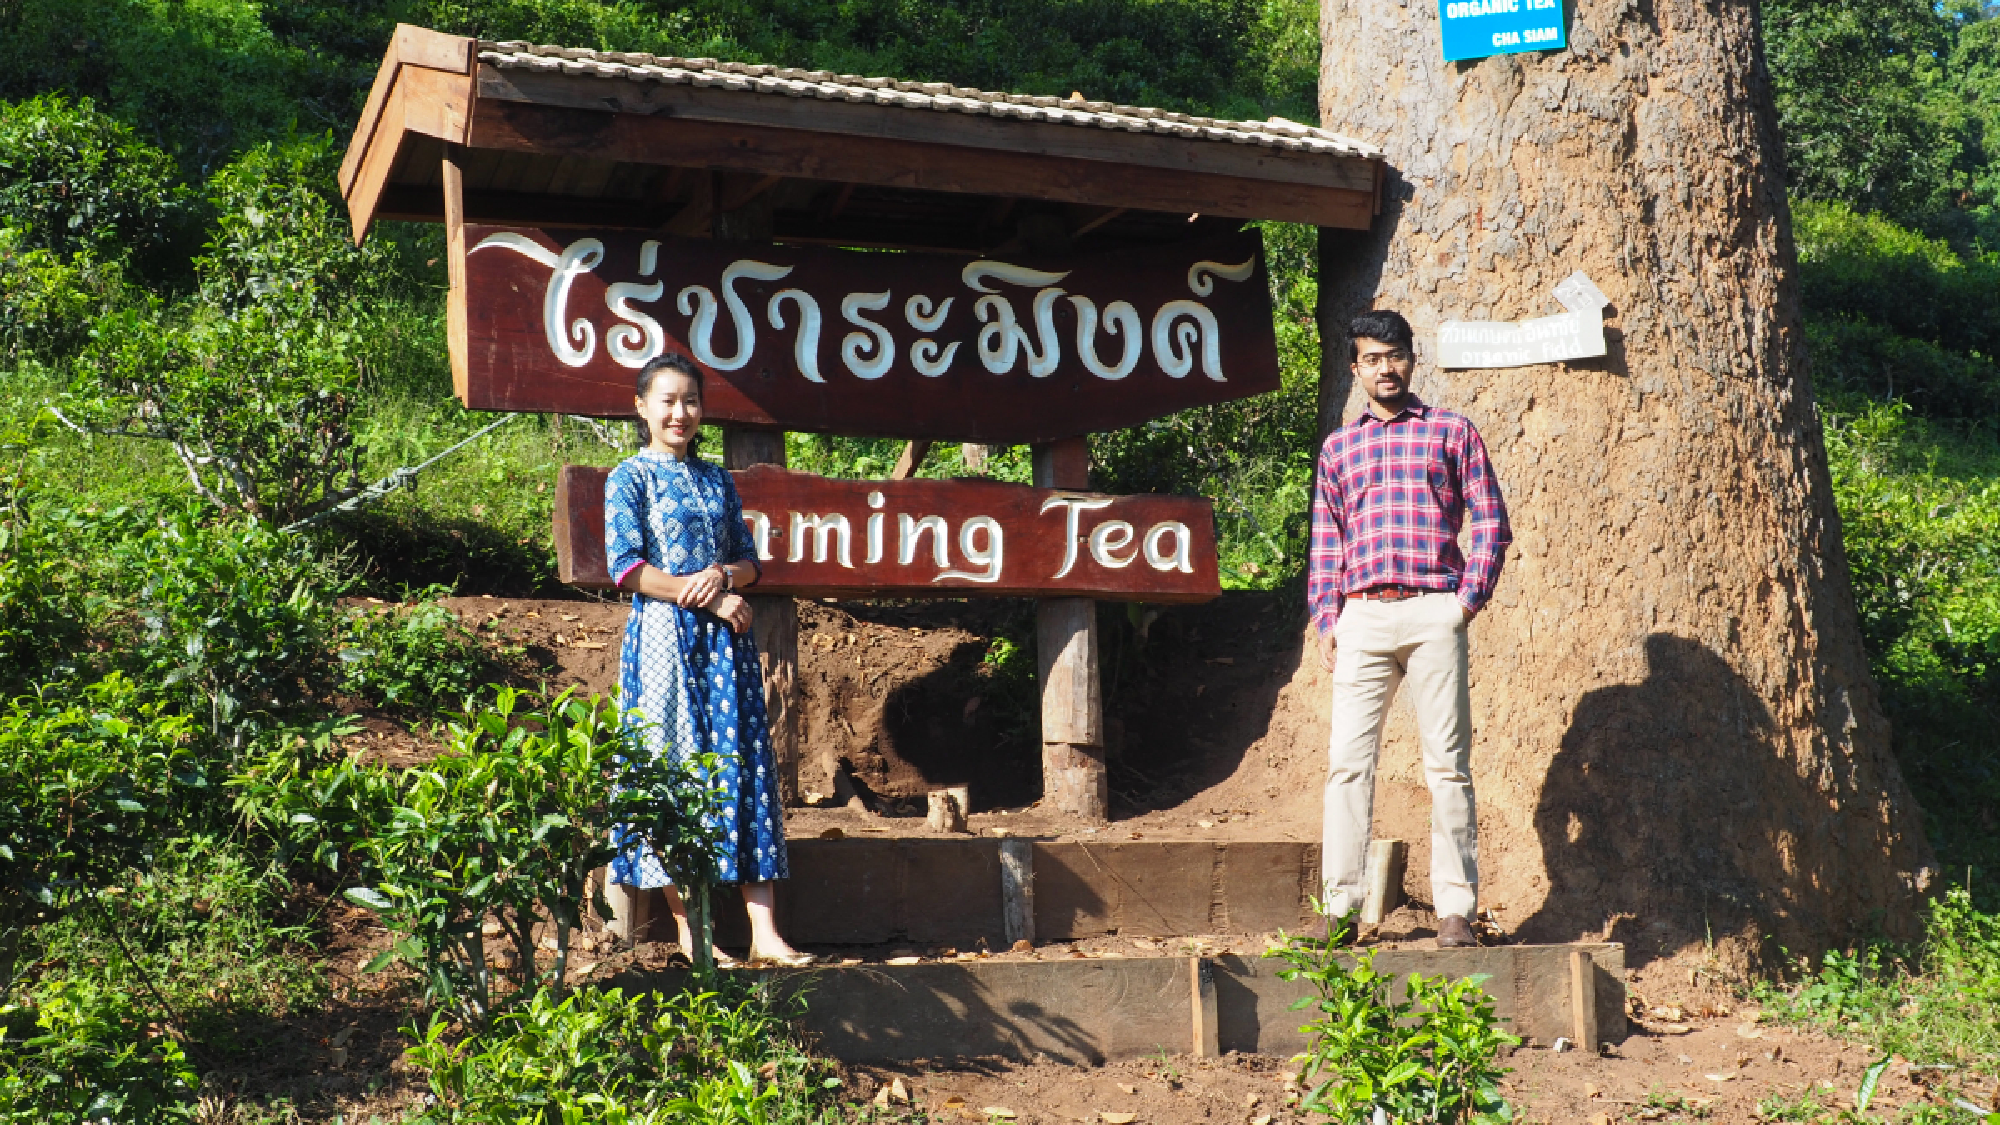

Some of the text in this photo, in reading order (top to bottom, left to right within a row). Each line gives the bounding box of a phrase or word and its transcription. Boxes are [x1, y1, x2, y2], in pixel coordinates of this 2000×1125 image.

[1446, 0, 1520, 19] ORGANIC
[1492, 27, 1558, 47] CHA SIAM
[1461, 347, 1531, 367] organic
[741, 491, 1194, 584] aming Tea
